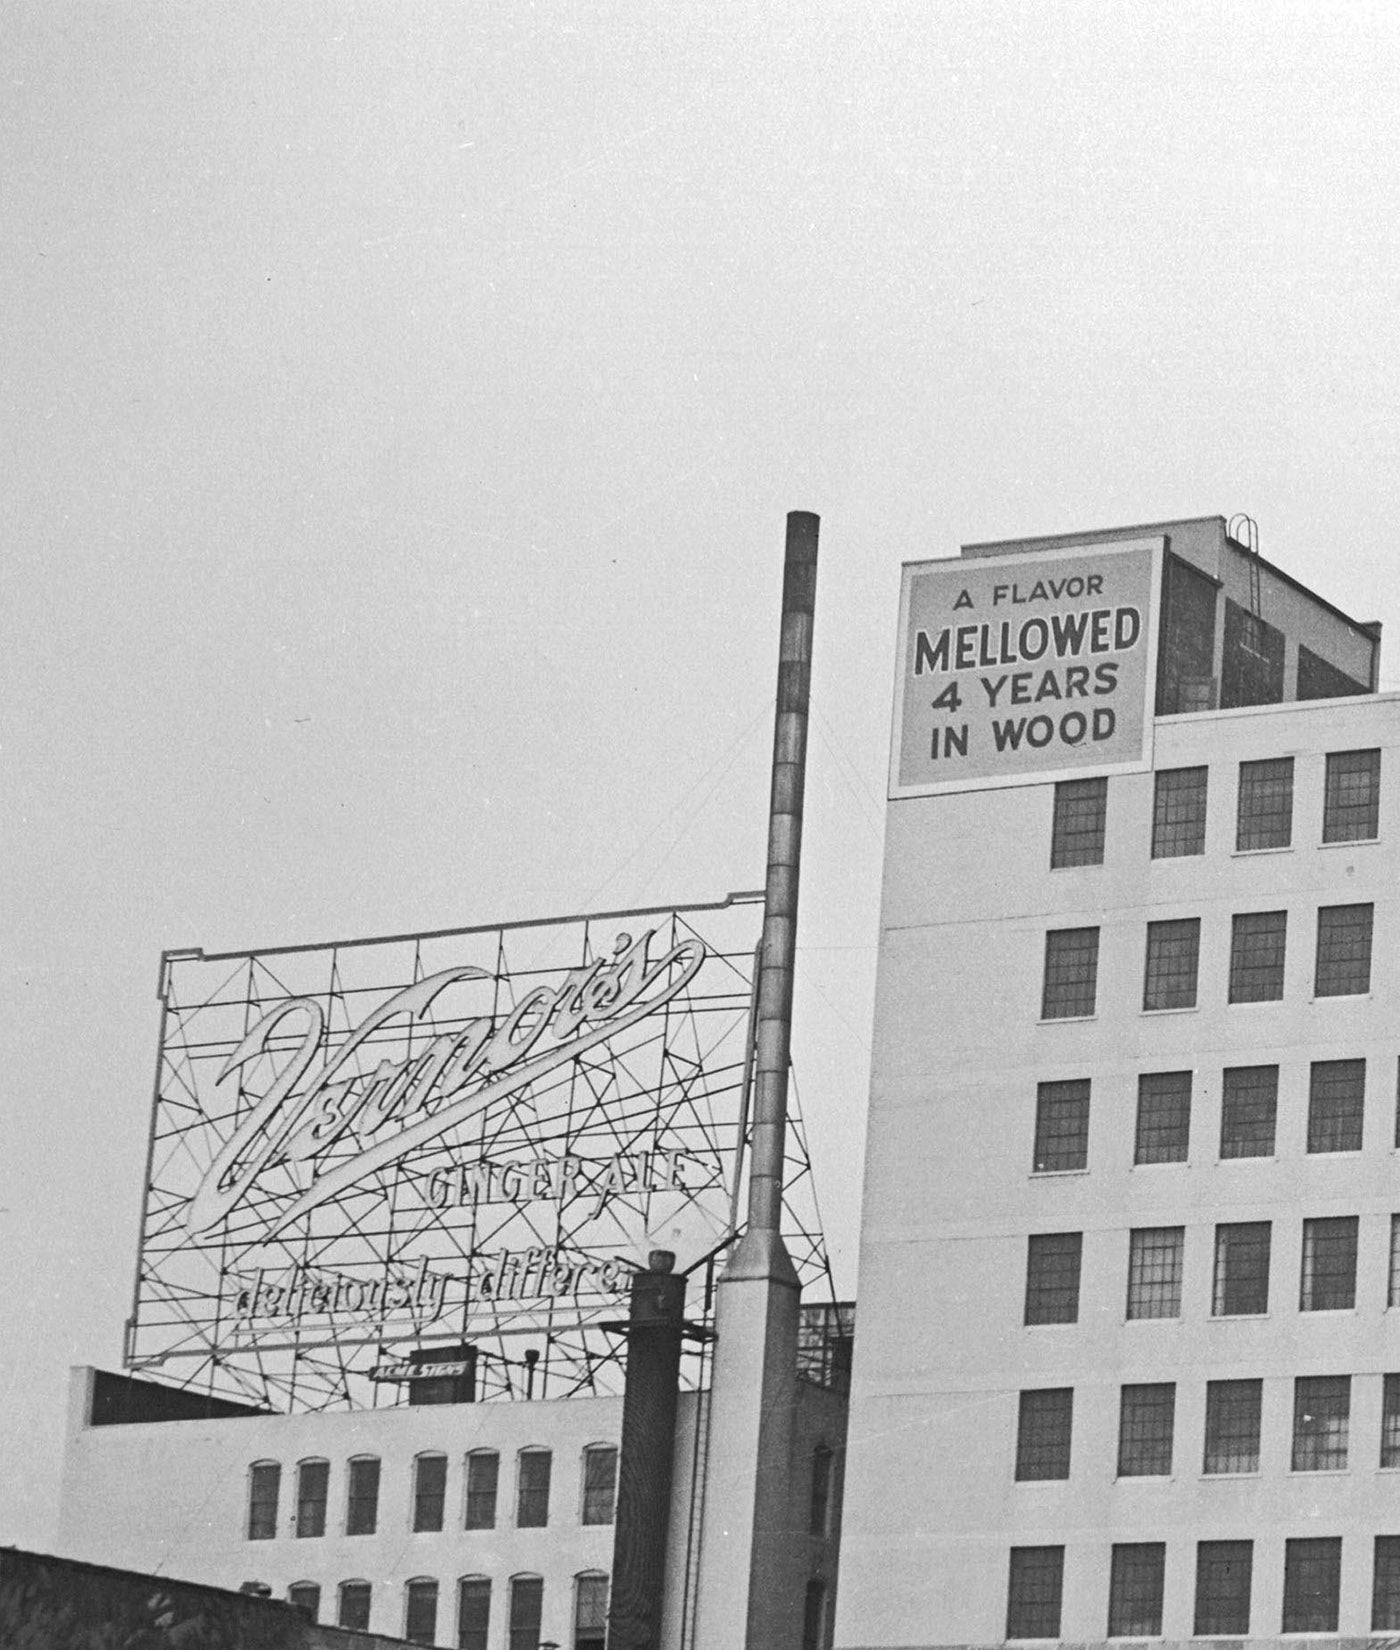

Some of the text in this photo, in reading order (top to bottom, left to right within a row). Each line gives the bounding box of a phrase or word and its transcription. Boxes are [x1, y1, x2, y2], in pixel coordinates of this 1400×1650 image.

[953, 574, 1104, 610] A FLAVOR
[914, 606, 1141, 676] MELLOWED
[931, 662, 1120, 713] 4 YEARS
[930, 707, 1117, 760] IN WOOD
[186, 929, 708, 1248] Vernor's
[424, 1150, 687, 1220] GINGER ALE
[234, 1245, 633, 1321] deliciously differen
